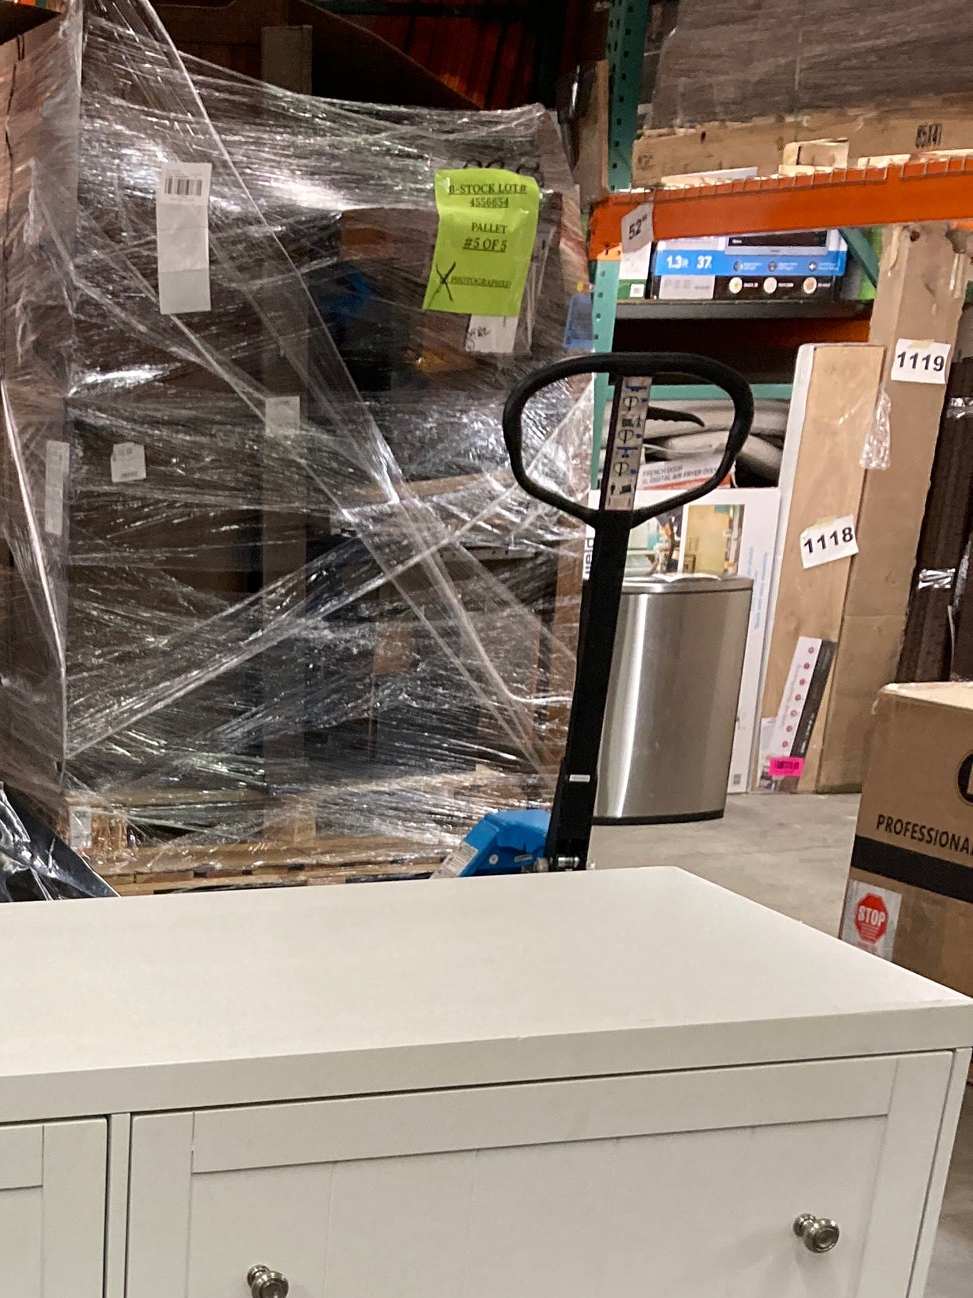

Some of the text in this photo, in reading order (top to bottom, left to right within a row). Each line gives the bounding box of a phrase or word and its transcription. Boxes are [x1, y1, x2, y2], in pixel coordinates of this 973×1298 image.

[471, 222, 508, 234] PALLET
[482, 239, 499, 251] OF
[500, 240, 508, 252] 5
[897, 351, 945, 372] 1119
[803, 526, 855, 554] 1118
[876, 813, 973, 857] PROFESSIONA
[857, 905, 886, 928] STOP
